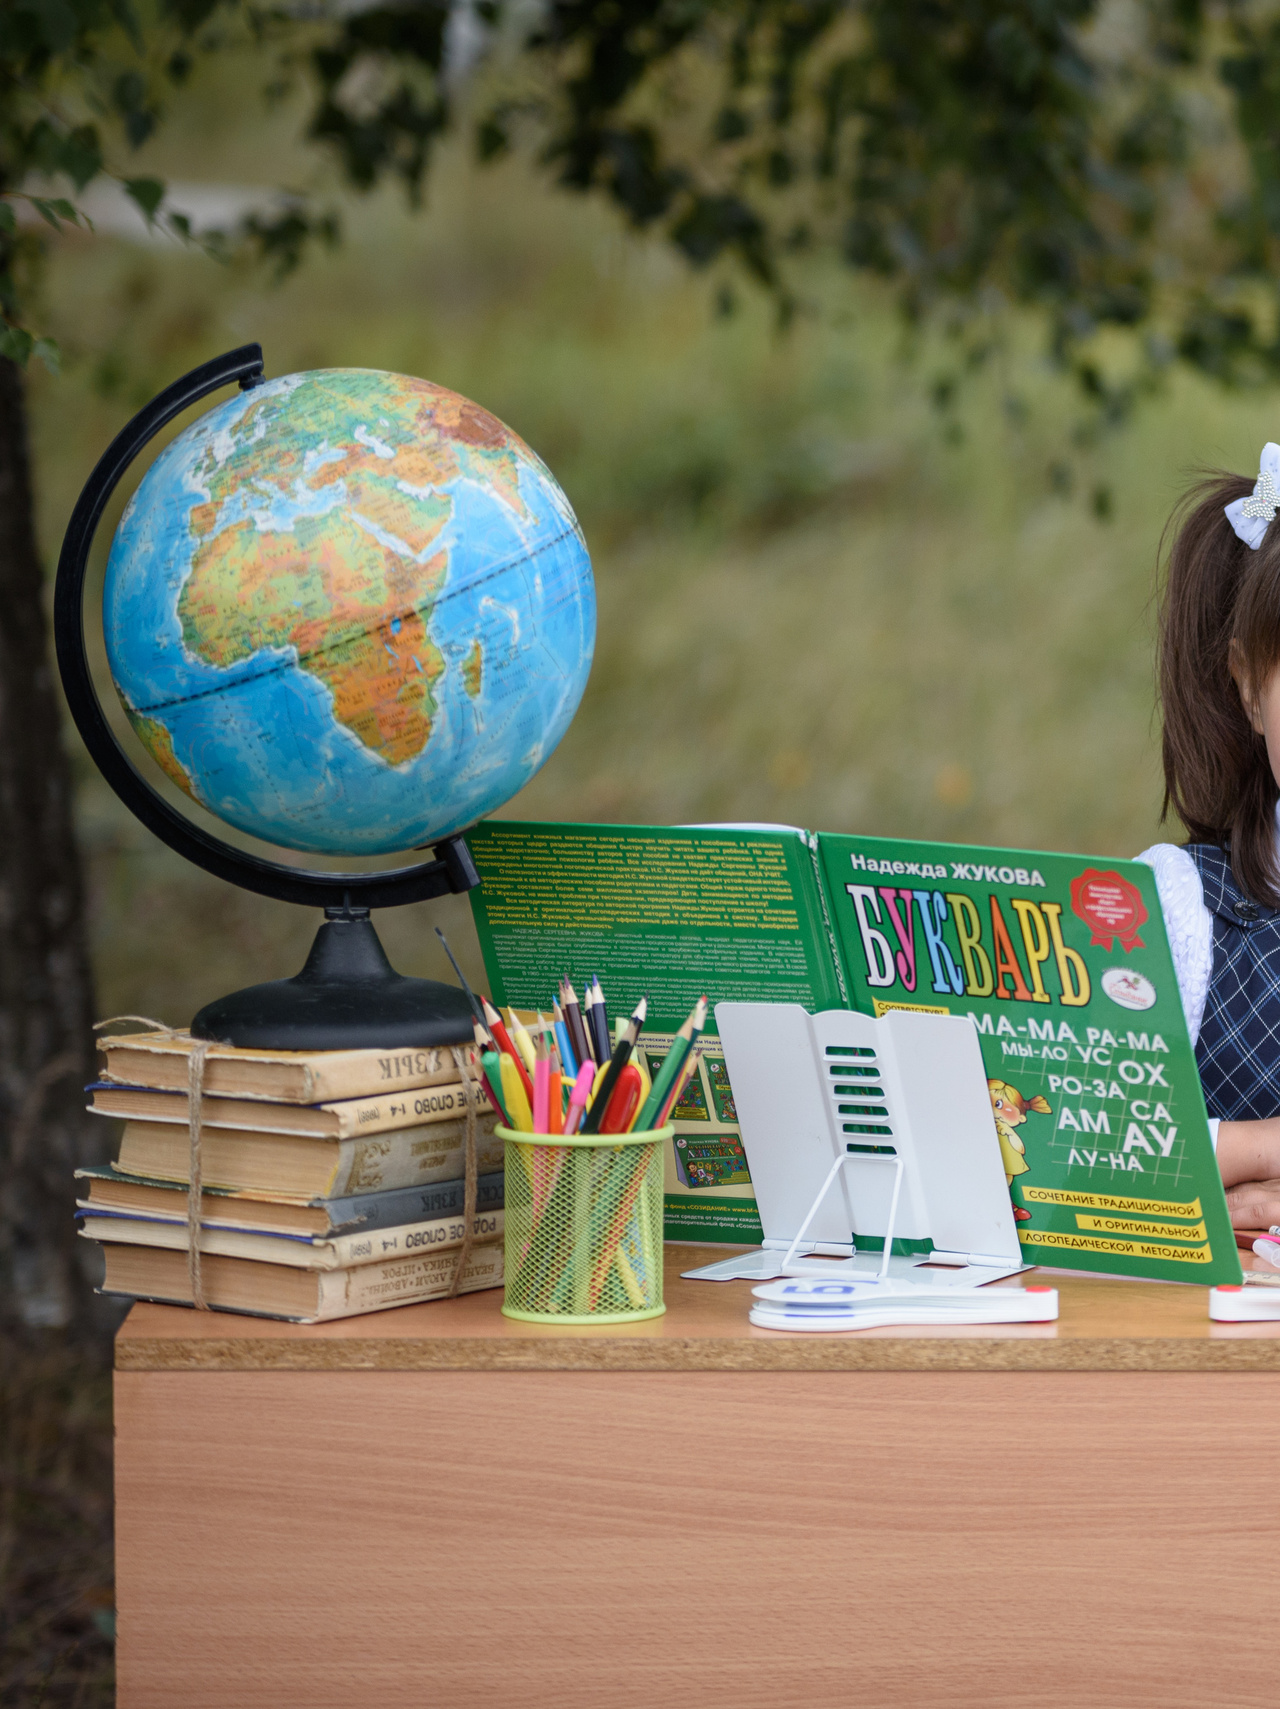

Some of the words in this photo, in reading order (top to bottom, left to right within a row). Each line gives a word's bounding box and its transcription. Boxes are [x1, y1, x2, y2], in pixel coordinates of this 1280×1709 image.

[850, 853, 947, 879] Надежда
[951, 862, 1046, 888] ЖУКОВА
[845, 883, 1091, 1006] БУКВАРЬ
[967, 1011, 1079, 1043] МА-МА
[1086, 1027, 1170, 1053] РА-МА
[378, 1050, 443, 1079] ЯЗЫК
[1001, 1042, 1068, 1061] МЫ-ЛО
[1075, 1045, 1112, 1066] УС
[1118, 1060, 1169, 1087] ОХ
[1048, 1075, 1127, 1100] РО-ЗА
[415, 1094, 453, 1115] СЛОВО
[1130, 1100, 1174, 1123] СА
[1058, 1107, 1112, 1134] АМ
[1122, 1122, 1178, 1157] АУ
[1068, 1148, 1144, 1172] ЛУ-НА
[1029, 1189, 1095, 1206] СОЧЕТАНИЕ
[1098, 1198, 1195, 1216] ТРАДИЦИОННОЙ
[406, 1227, 446, 1249] СЛОВО
[450, 1217, 496, 1240] РОДОЕ
[1093, 1219, 1102, 1229] И
[1105, 1220, 1200, 1238] ОРИГИНАЛЬНОЙ
[1026, 1233, 1134, 1253] ЛОГОПЕДИЧЕСКОЙ
[1141, 1246, 1205, 1261] МЕТОДИКИ
